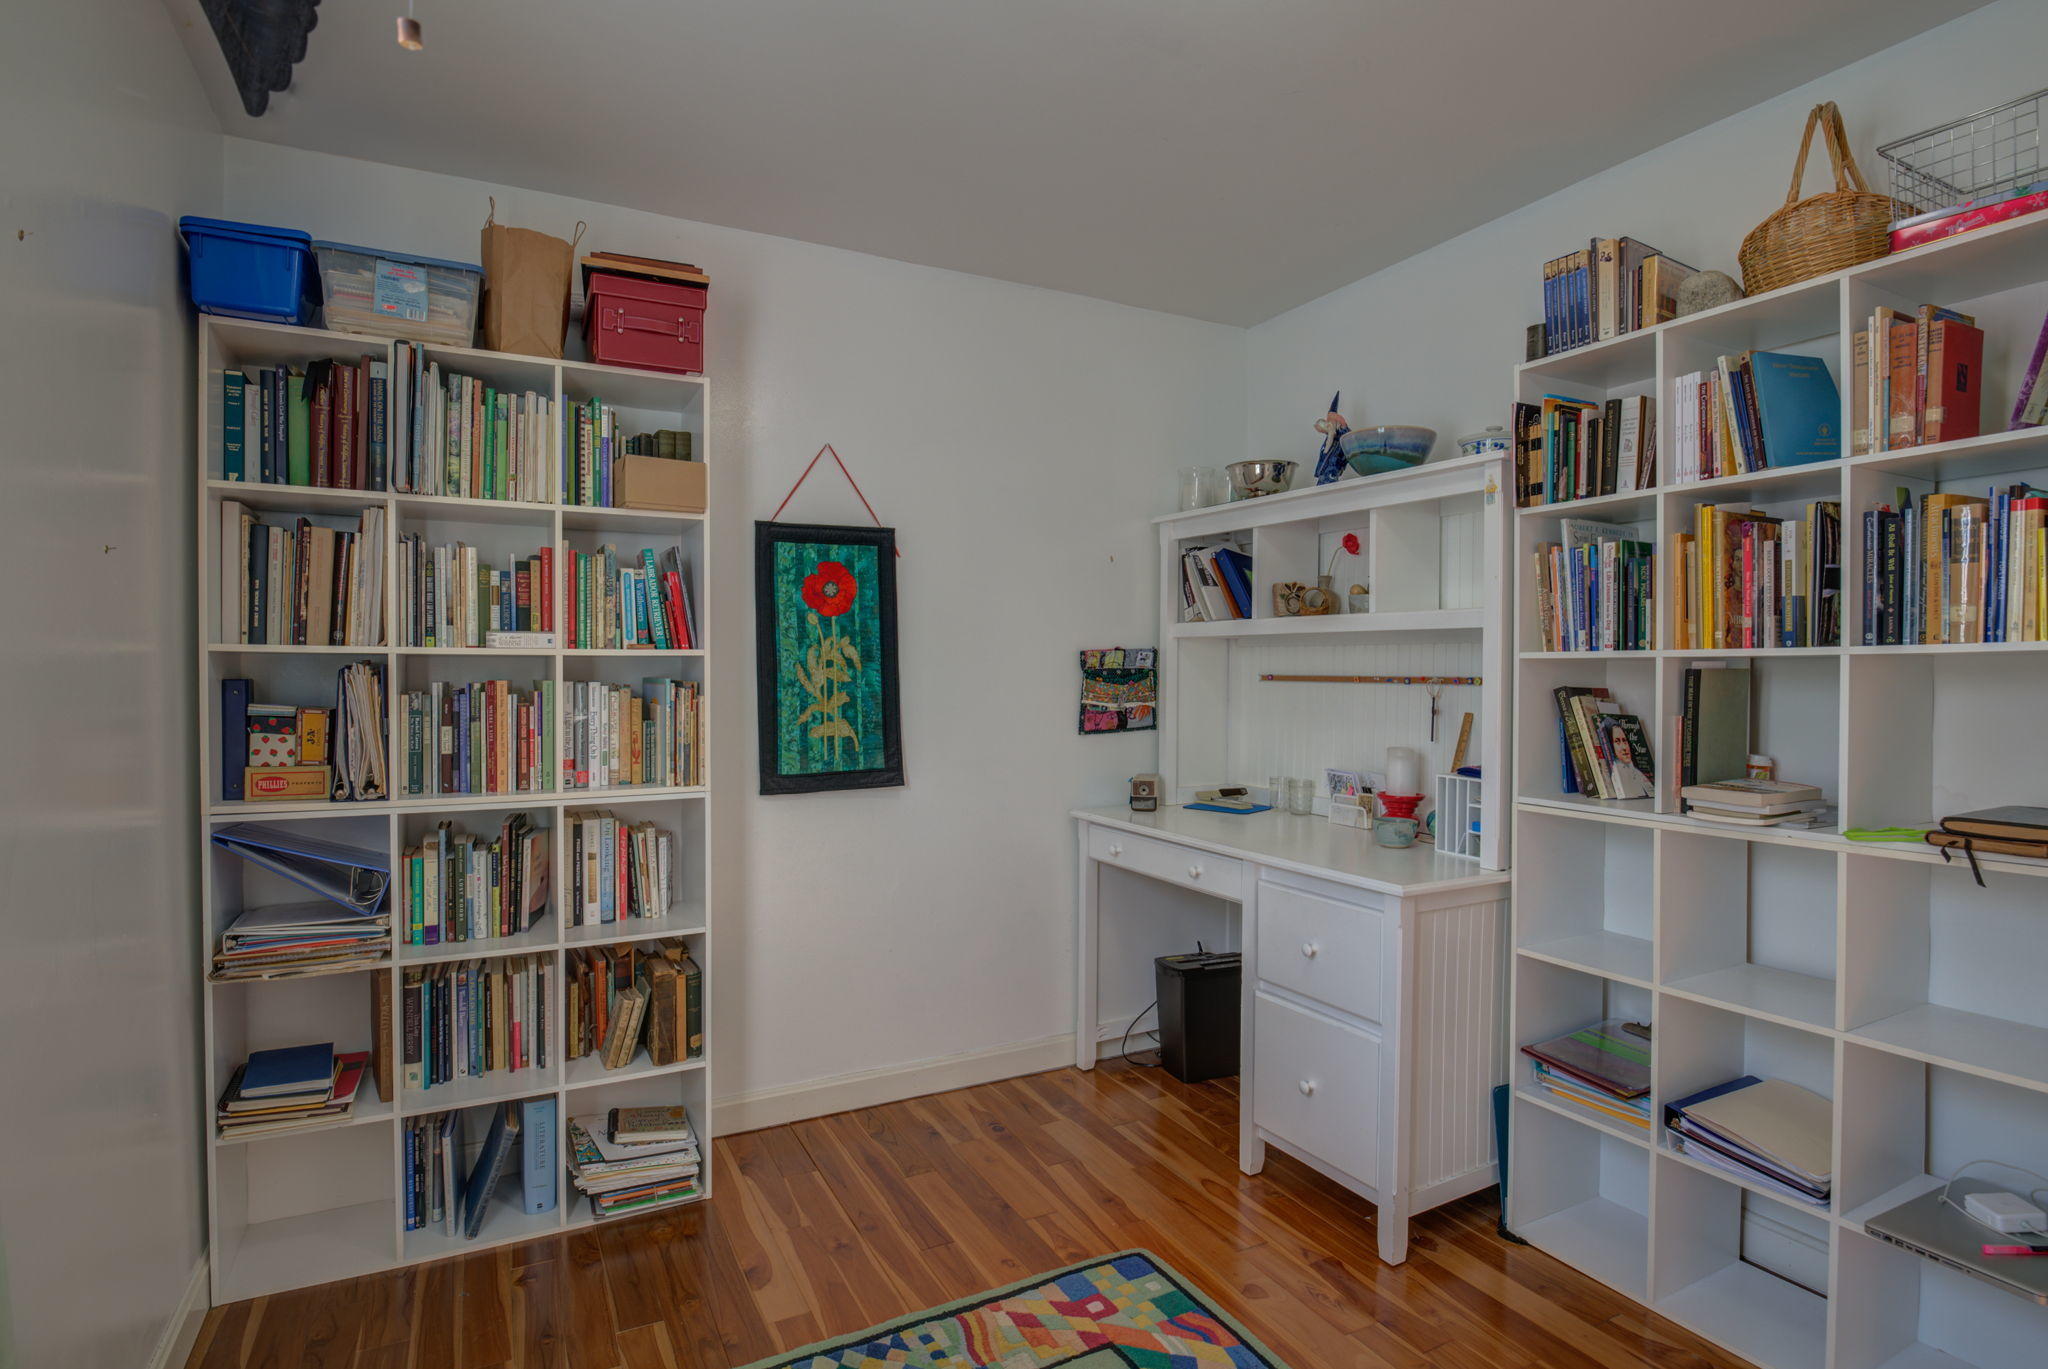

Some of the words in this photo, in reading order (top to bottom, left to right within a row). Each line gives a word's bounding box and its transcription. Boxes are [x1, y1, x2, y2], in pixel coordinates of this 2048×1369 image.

[376, 380, 384, 401] HANDS
[376, 402, 384, 412] ON
[376, 413, 384, 425] THE
[376, 426, 384, 443] LAND
[1930, 503, 1941, 558] Attachments
[645, 559, 659, 597] LABRADOR
[502, 594, 510, 624] WALDEN
[635, 582, 646, 623] Wildflowers
[651, 598, 664, 637] RETRIEVER
[1619, 718, 1640, 732] Through
[1632, 743, 1647, 755] Year
[257, 780, 288, 790] PHILLIES
[603, 836, 612, 873] Looking
